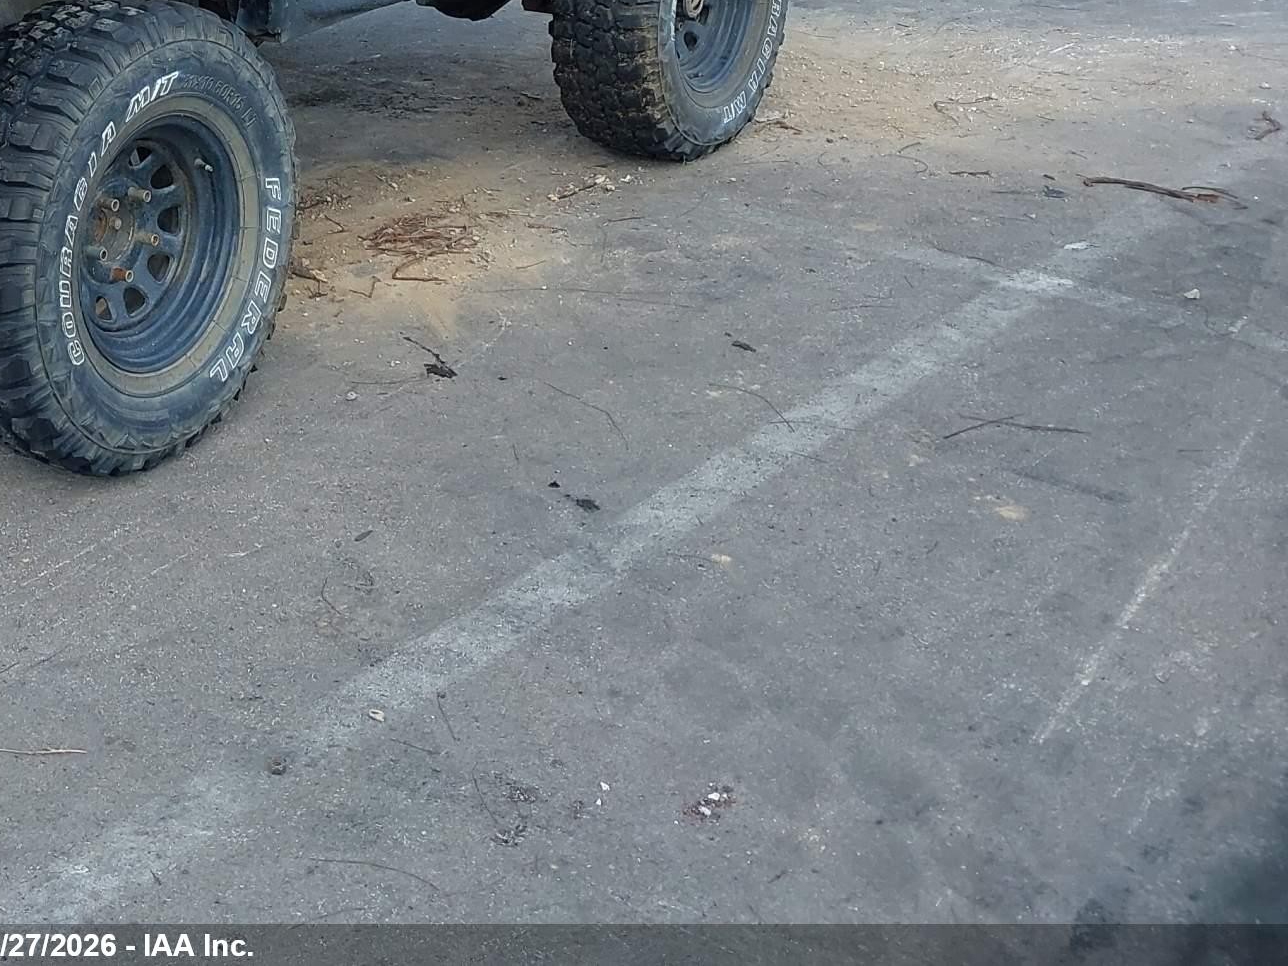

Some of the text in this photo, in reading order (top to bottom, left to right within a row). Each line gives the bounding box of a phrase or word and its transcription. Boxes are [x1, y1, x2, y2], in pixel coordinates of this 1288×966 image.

[723, 90, 747, 124] M/T
[59, 71, 179, 366] COURAGIA M/T
[209, 177, 282, 382] FEDERAL
